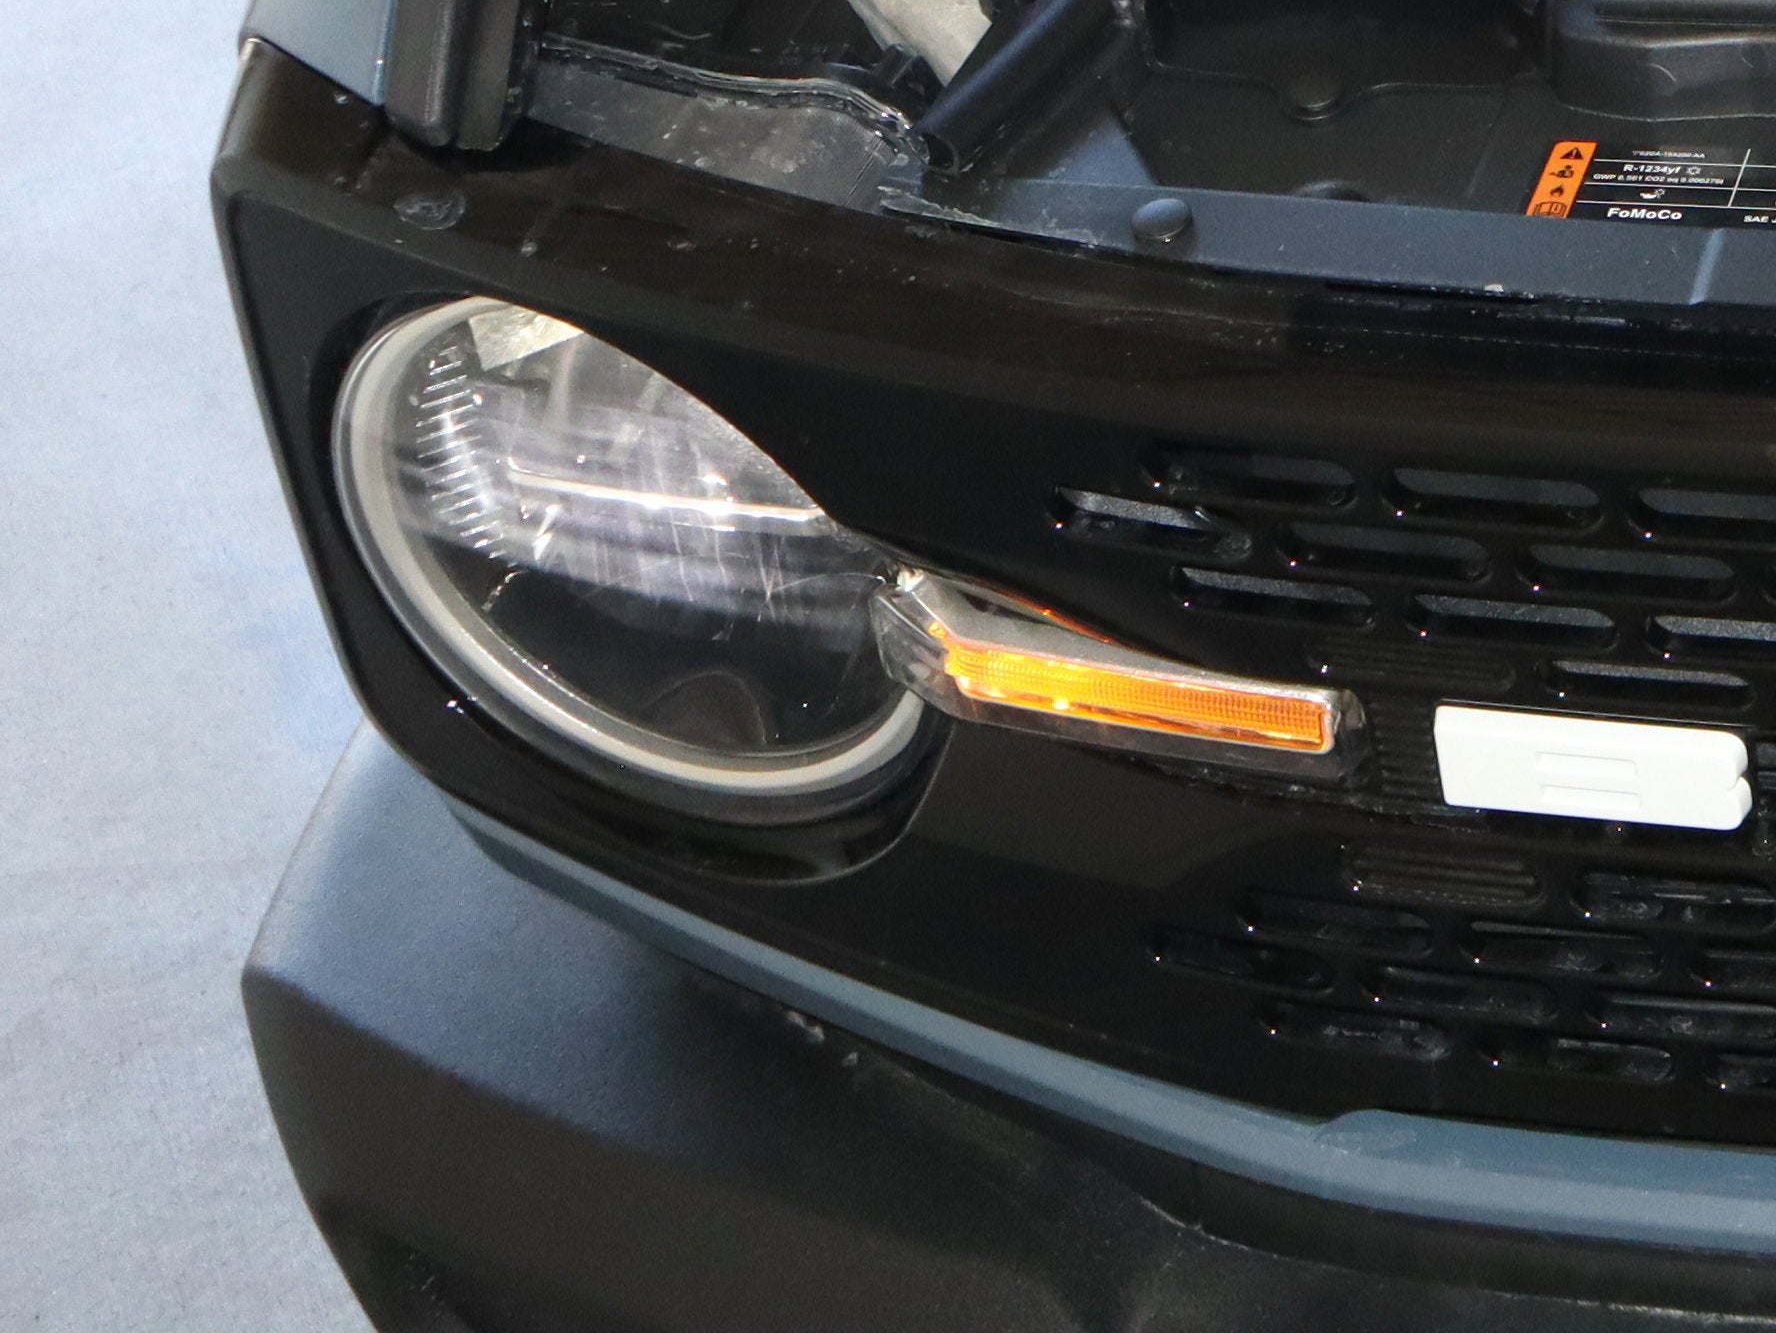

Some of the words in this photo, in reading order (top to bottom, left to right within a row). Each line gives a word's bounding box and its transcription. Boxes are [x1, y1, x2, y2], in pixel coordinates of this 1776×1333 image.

[1623, 163, 1682, 175] R-1234yf
[1593, 173, 1616, 181] GWP
[1606, 207, 1683, 221] FoMoCo
[1743, 215, 1769, 223] SAE
